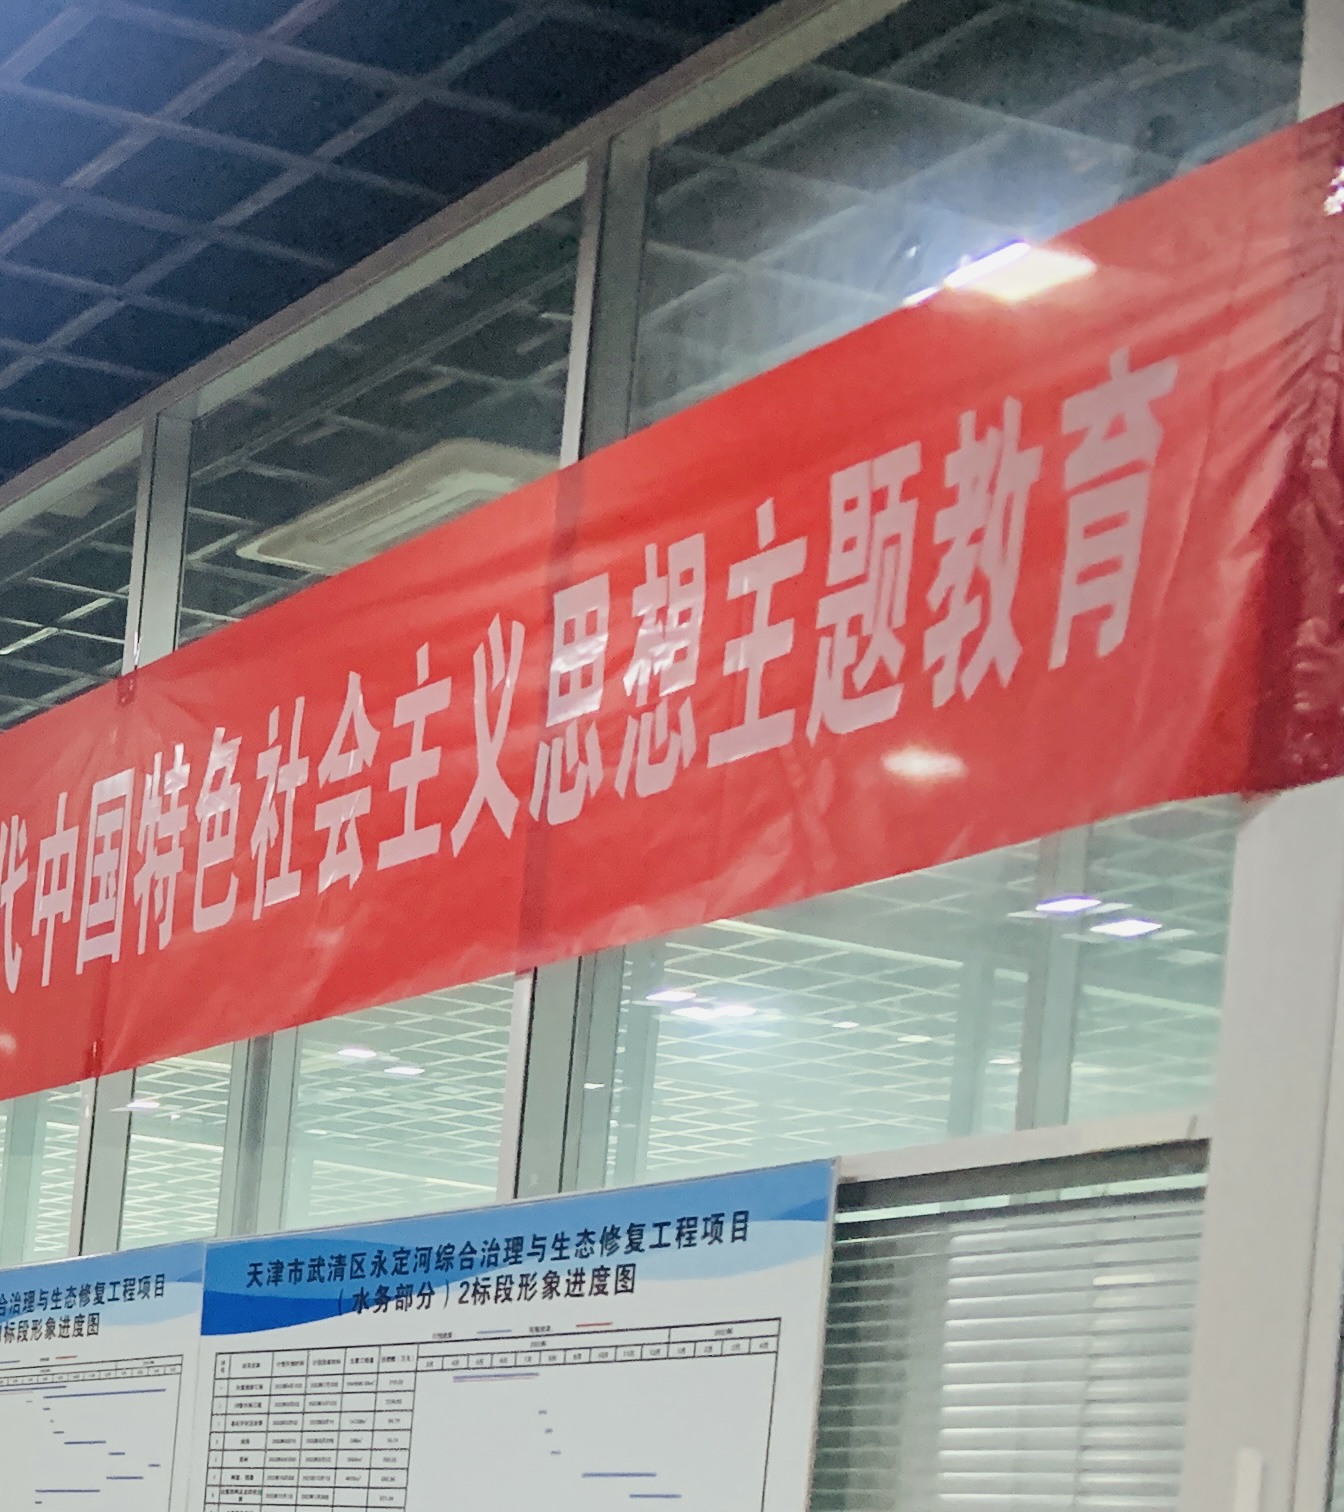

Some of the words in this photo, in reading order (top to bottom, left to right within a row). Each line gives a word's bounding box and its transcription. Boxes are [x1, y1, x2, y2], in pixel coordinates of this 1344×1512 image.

[246, 1209, 750, 1289] 天津市武清区永定河综合治理与生态修复工程项目
[337, 1262, 637, 1317] （水务部分）2标段形象进度图
